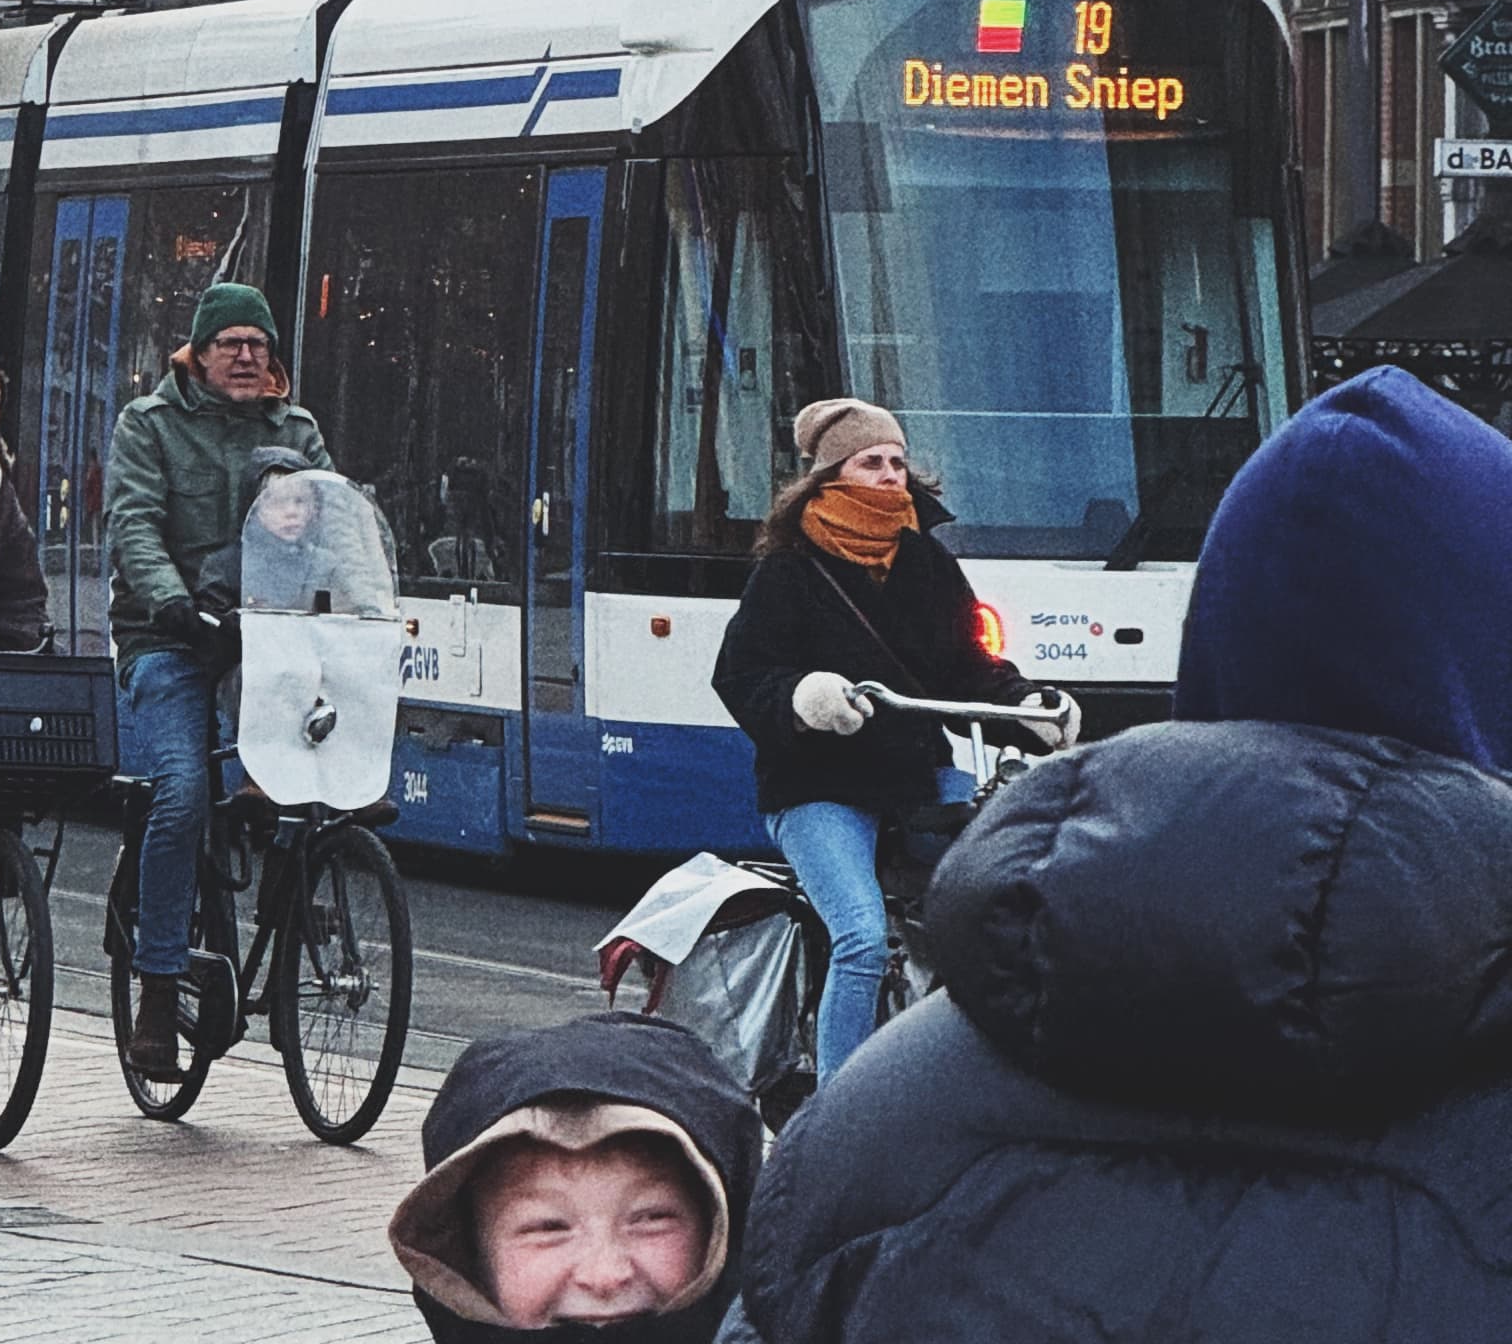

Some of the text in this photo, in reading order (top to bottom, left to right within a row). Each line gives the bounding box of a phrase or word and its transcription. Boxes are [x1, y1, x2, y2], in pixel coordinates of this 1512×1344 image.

[1074, 0, 1112, 55] 19
[1470, 35, 1512, 59] Bra
[904, 59, 1185, 121] Diemen Sniep
[1059, 614, 1089, 625] GVB
[414, 645, 439, 681] GVB
[1035, 643, 1088, 661] 3044
[402, 771, 428, 805] 3044
